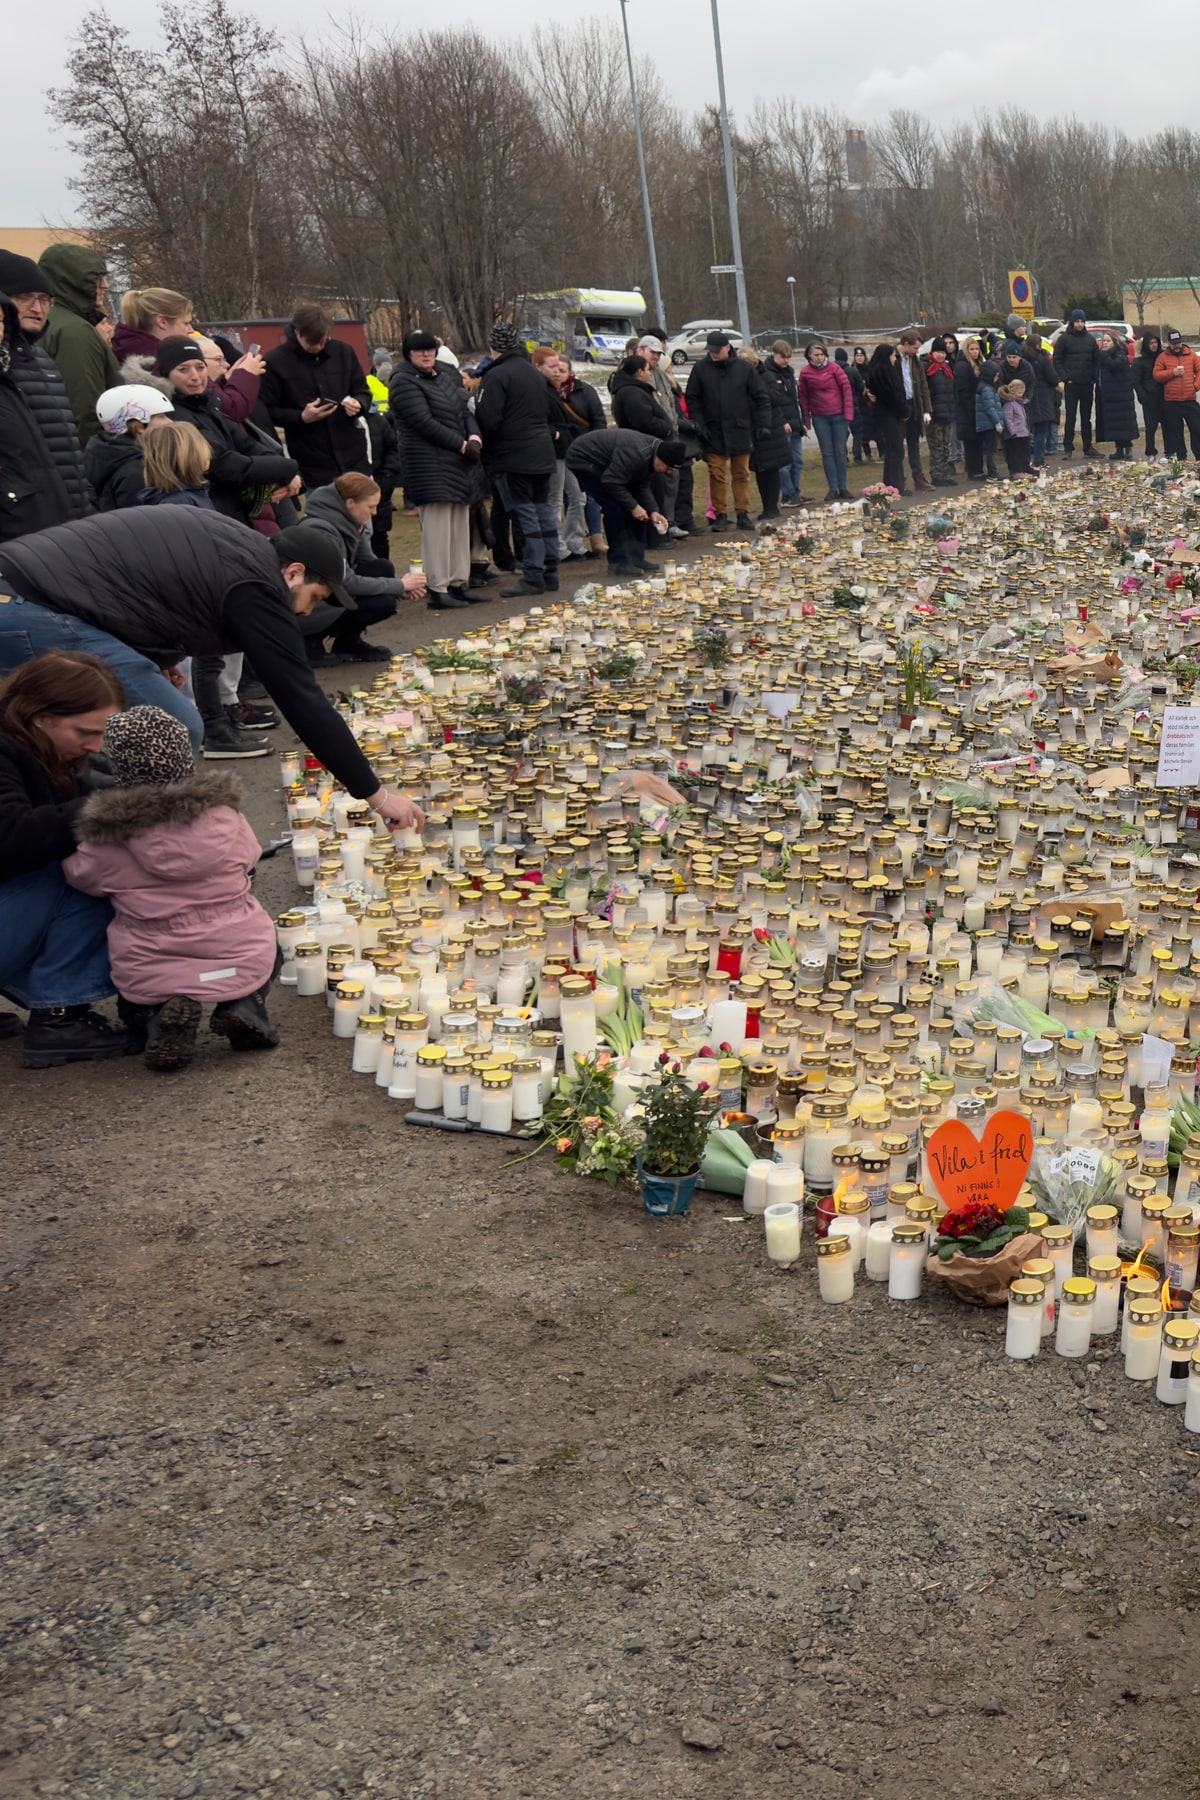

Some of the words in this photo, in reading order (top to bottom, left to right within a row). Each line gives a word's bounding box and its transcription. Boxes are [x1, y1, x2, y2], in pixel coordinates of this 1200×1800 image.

[932, 1145, 977, 1181] Vila
[980, 1150, 985, 1164] i
[989, 1133, 1027, 1174] frid
